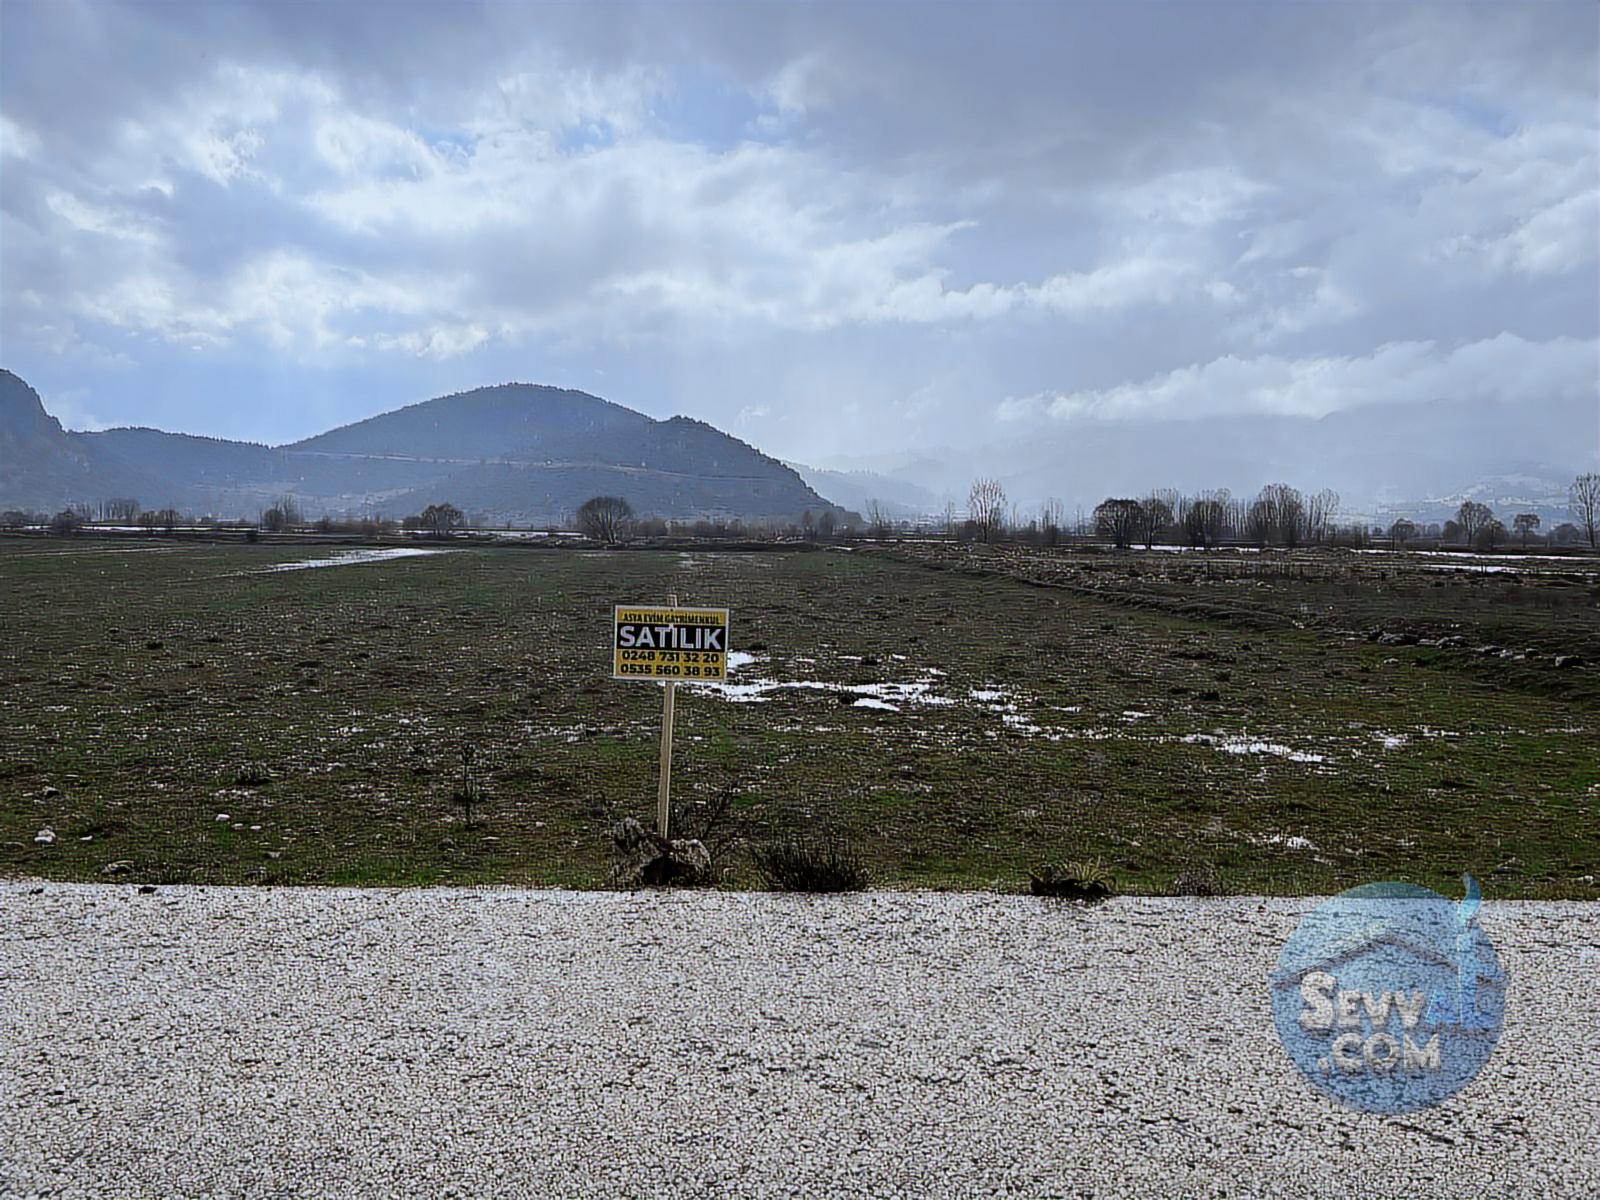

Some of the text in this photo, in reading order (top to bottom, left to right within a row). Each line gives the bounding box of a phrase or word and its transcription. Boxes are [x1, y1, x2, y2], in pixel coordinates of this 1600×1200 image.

[620, 625, 722, 649] SATILIK
[622, 650, 720, 663] 0248 731 32 20
[620, 664, 720, 676] 0535 560 38 93
